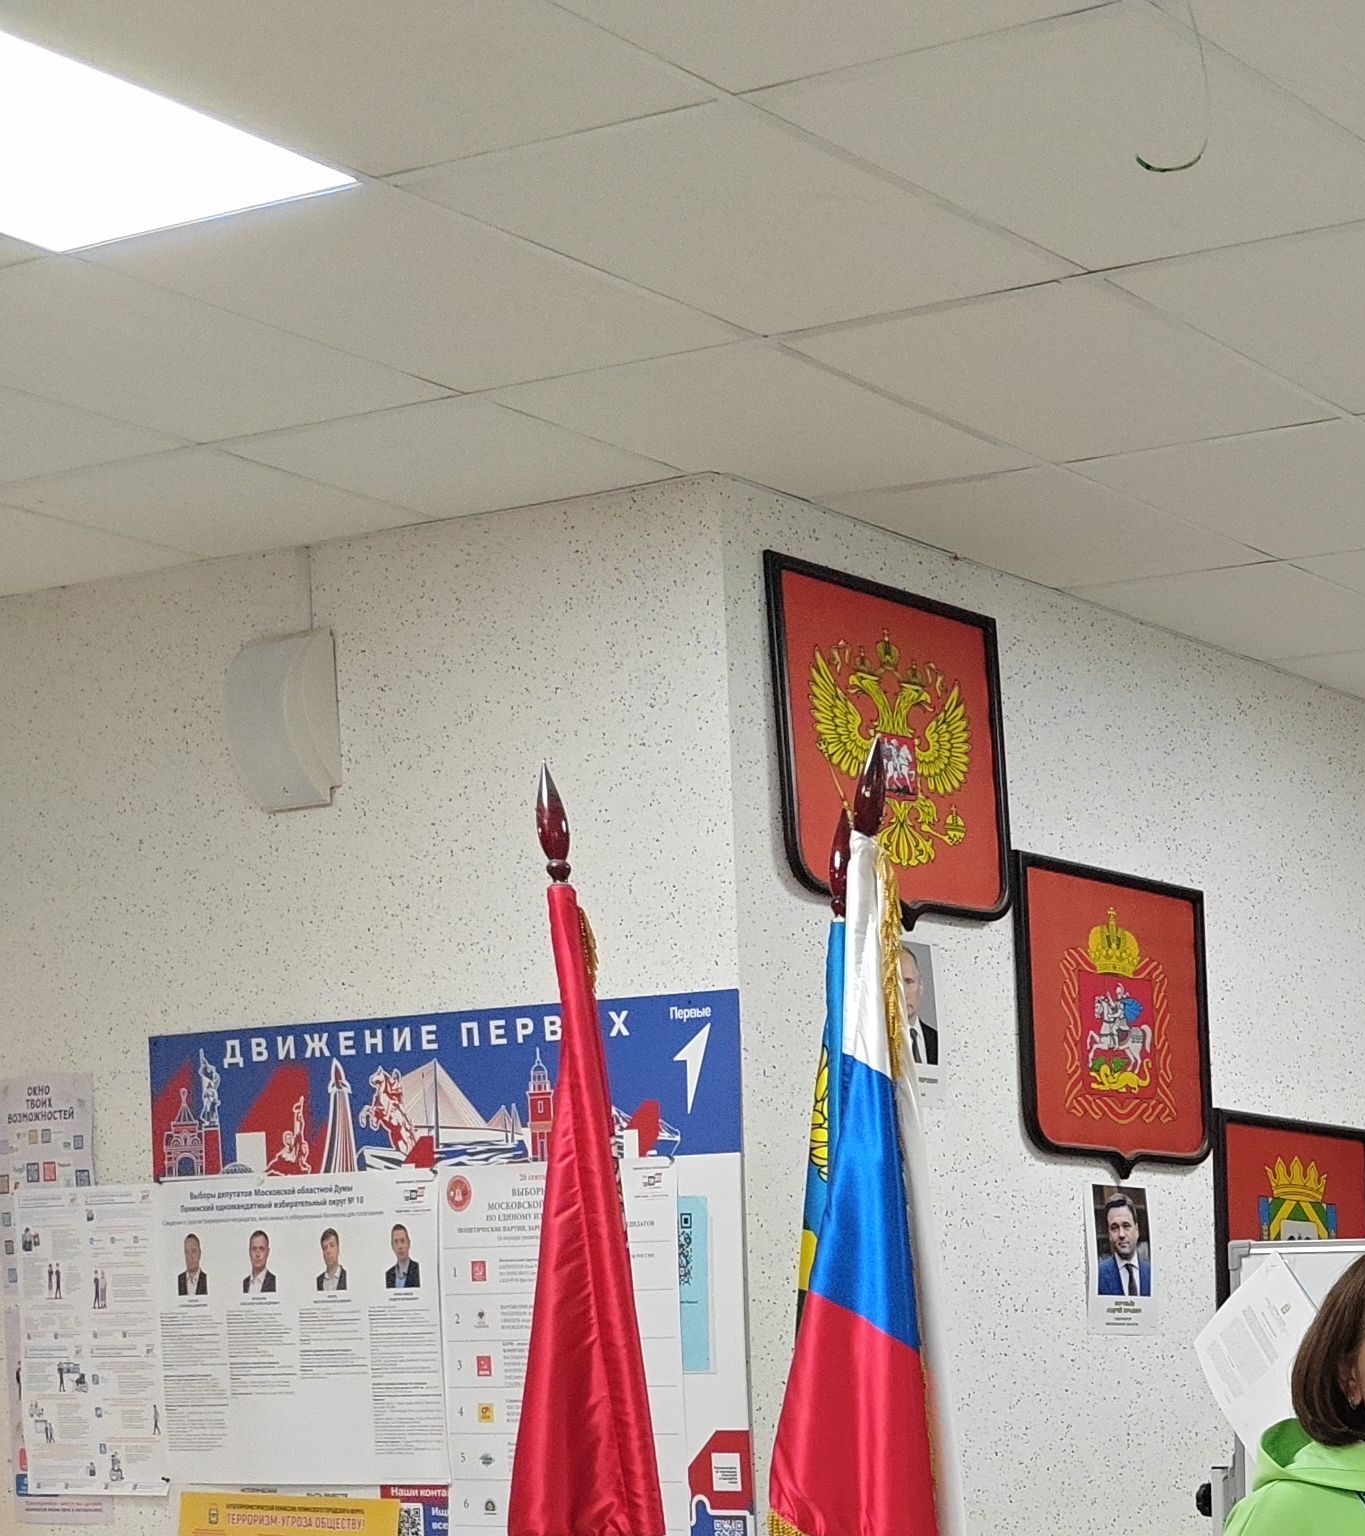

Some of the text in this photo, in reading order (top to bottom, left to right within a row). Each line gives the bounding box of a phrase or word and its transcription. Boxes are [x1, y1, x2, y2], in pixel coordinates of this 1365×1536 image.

[669, 1005, 711, 1020] Первые
[223, 1011, 631, 1068] ДВИЖЕНИЕ ПЕРВХ
[28, 1085, 50, 1096] ОКНО
[26, 1098, 52, 1108] ТВОИХ
[8, 1107, 74, 1124] ВОЗМОЖНОСТЕЙ
[189, 1191, 216, 1200] Выборы
[254, 1186, 295, 1197] Московской
[356, 1196, 364, 1204] 10
[453, 1268, 457, 1277] 1
[455, 1314, 460, 1324] 2
[457, 1361, 462, 1370] 3
[458, 1407, 463, 1417] 4
[461, 1453, 466, 1462] 5
[391, 1487, 448, 1498] Наши конта
[464, 1499, 469, 1508] 6
[227, 1513, 365, 1530] ТЕРРОРИЗМ-УГРОЗА ОБЩЕСТВУ!
